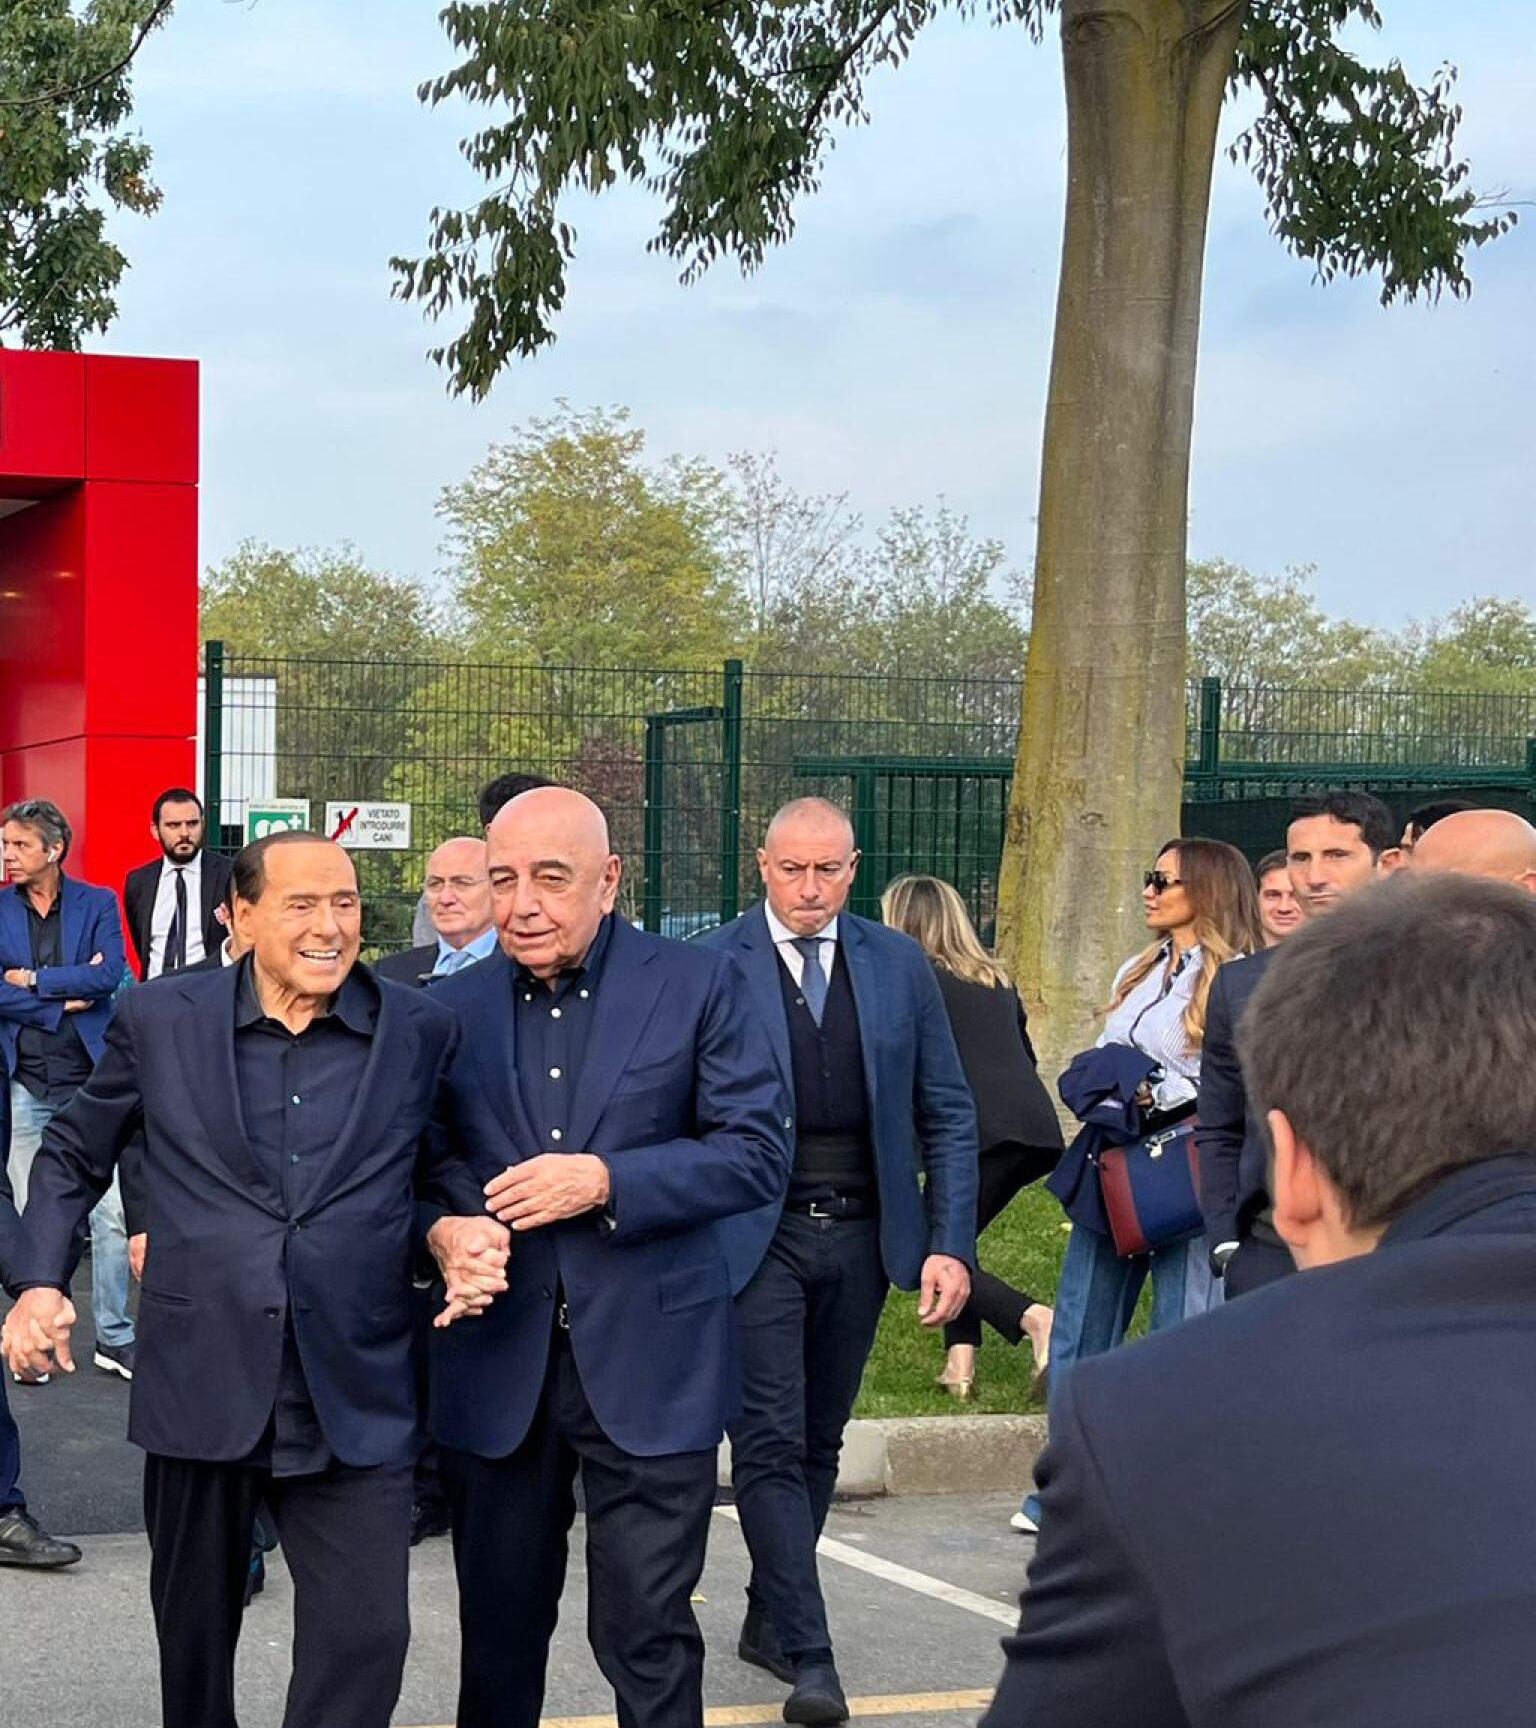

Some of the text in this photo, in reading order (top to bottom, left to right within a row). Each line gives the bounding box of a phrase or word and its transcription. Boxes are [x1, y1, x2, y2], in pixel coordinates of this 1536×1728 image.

[368, 808, 400, 818] VIETATO
[360, 820, 406, 831] INTRODURRE
[373, 832, 393, 842] CANI
